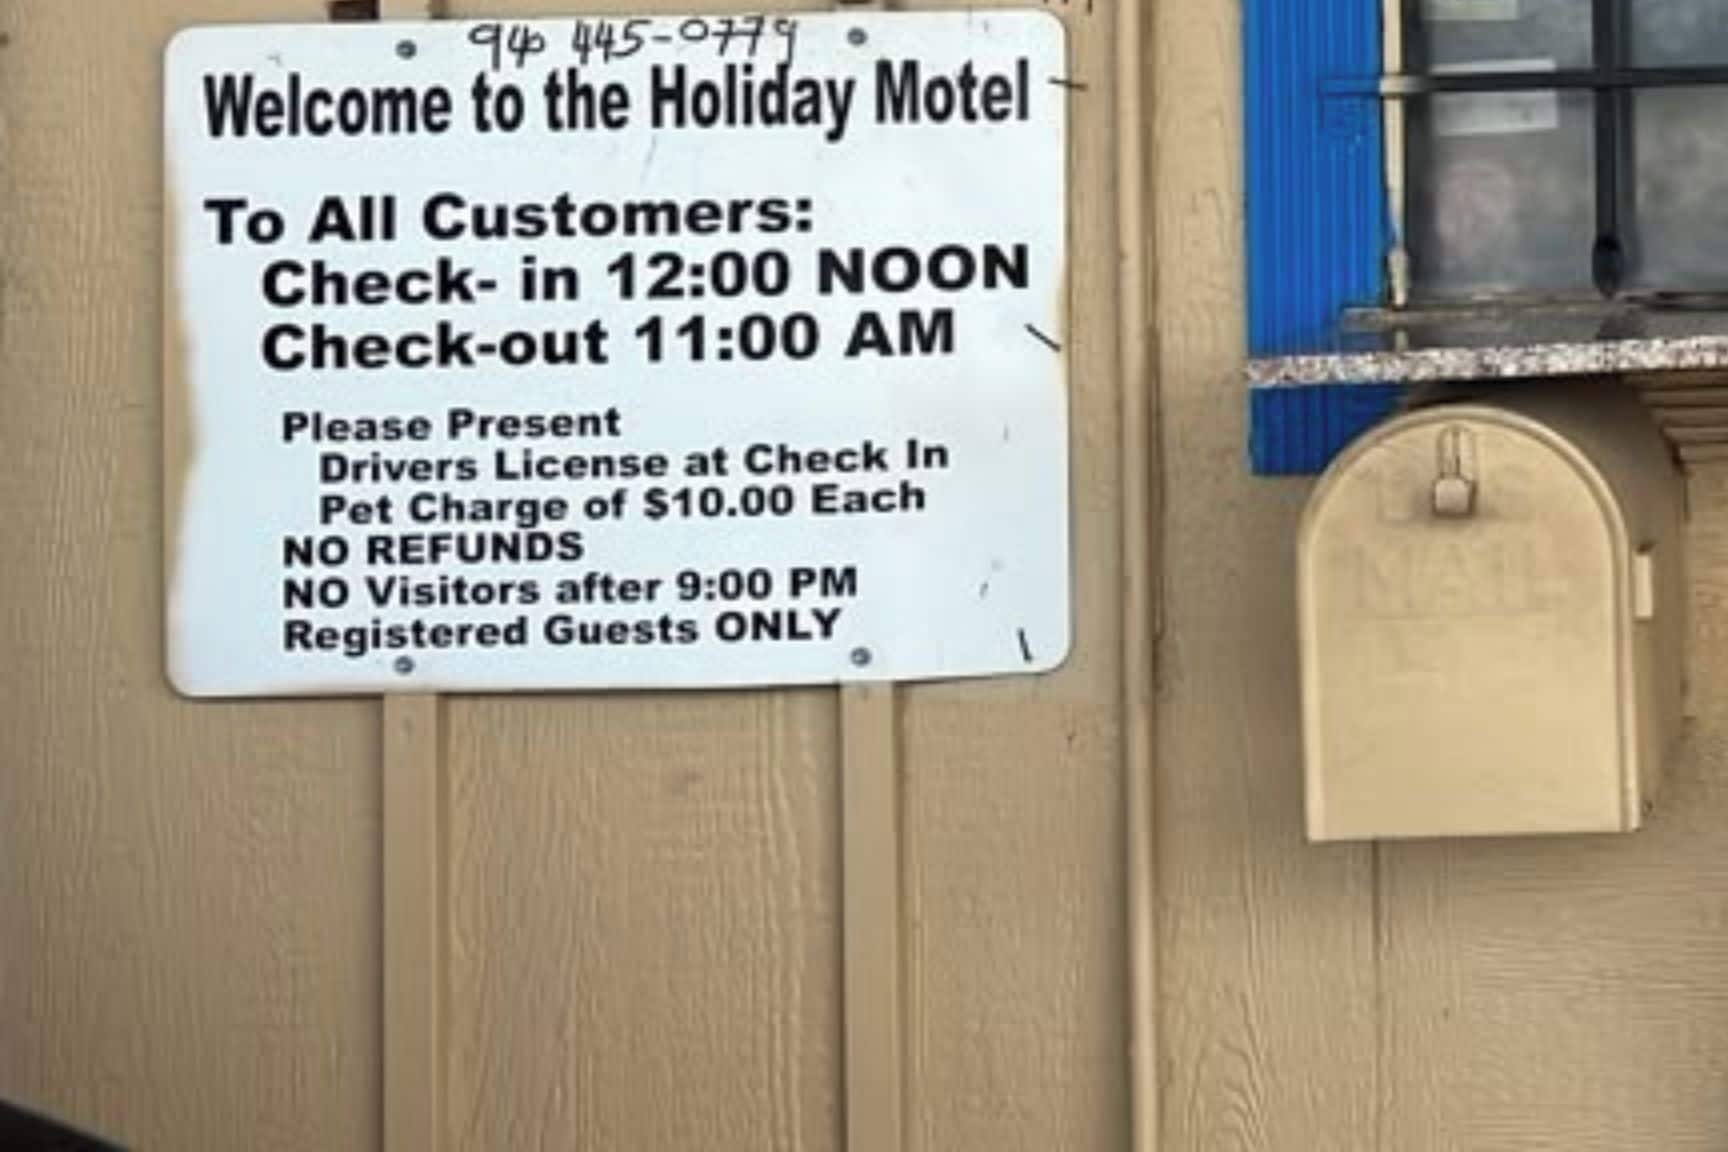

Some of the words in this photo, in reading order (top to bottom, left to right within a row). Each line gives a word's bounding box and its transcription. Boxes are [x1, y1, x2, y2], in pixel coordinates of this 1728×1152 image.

[203, 72, 452, 138] Welcome
[471, 70, 525, 133] to
[543, 67, 630, 132] the
[651, 62, 856, 141] Holiday
[876, 58, 1028, 124] Motel
[203, 198, 285, 245] To
[309, 195, 395, 243] All
[423, 192, 812, 241] Customers:
[262, 257, 497, 307] Check-
[522, 255, 578, 301] in
[607, 250, 790, 300] 12:00
[818, 243, 1028, 295] NOON
[262, 319, 608, 371] Check-out
[635, 312, 819, 362] 11:00
[844, 308, 953, 357] AM
[283, 411, 431, 443] Please
[448, 407, 620, 439] Present
[320, 451, 477, 484] Drivers
[495, 449, 669, 480] License
[684, 447, 727, 477] at
[744, 441, 888, 475] Check
[907, 439, 948, 469] In
[321, 495, 392, 525] Pet
[409, 492, 568, 525] Charge
[584, 488, 626, 520] of
[644, 485, 794, 520] $10.00
[812, 480, 925, 514] Each
[283, 535, 349, 567] NO
[367, 531, 584, 565] REFUNDS
[284, 577, 349, 609] NO
[366, 575, 540, 607] Visitors
[556, 571, 662, 604] after
[676, 568, 772, 601] 9:00
[790, 566, 857, 598] PM
[284, 615, 527, 655] Registered
[544, 614, 699, 645] Guests
[715, 607, 841, 642] ONLY
